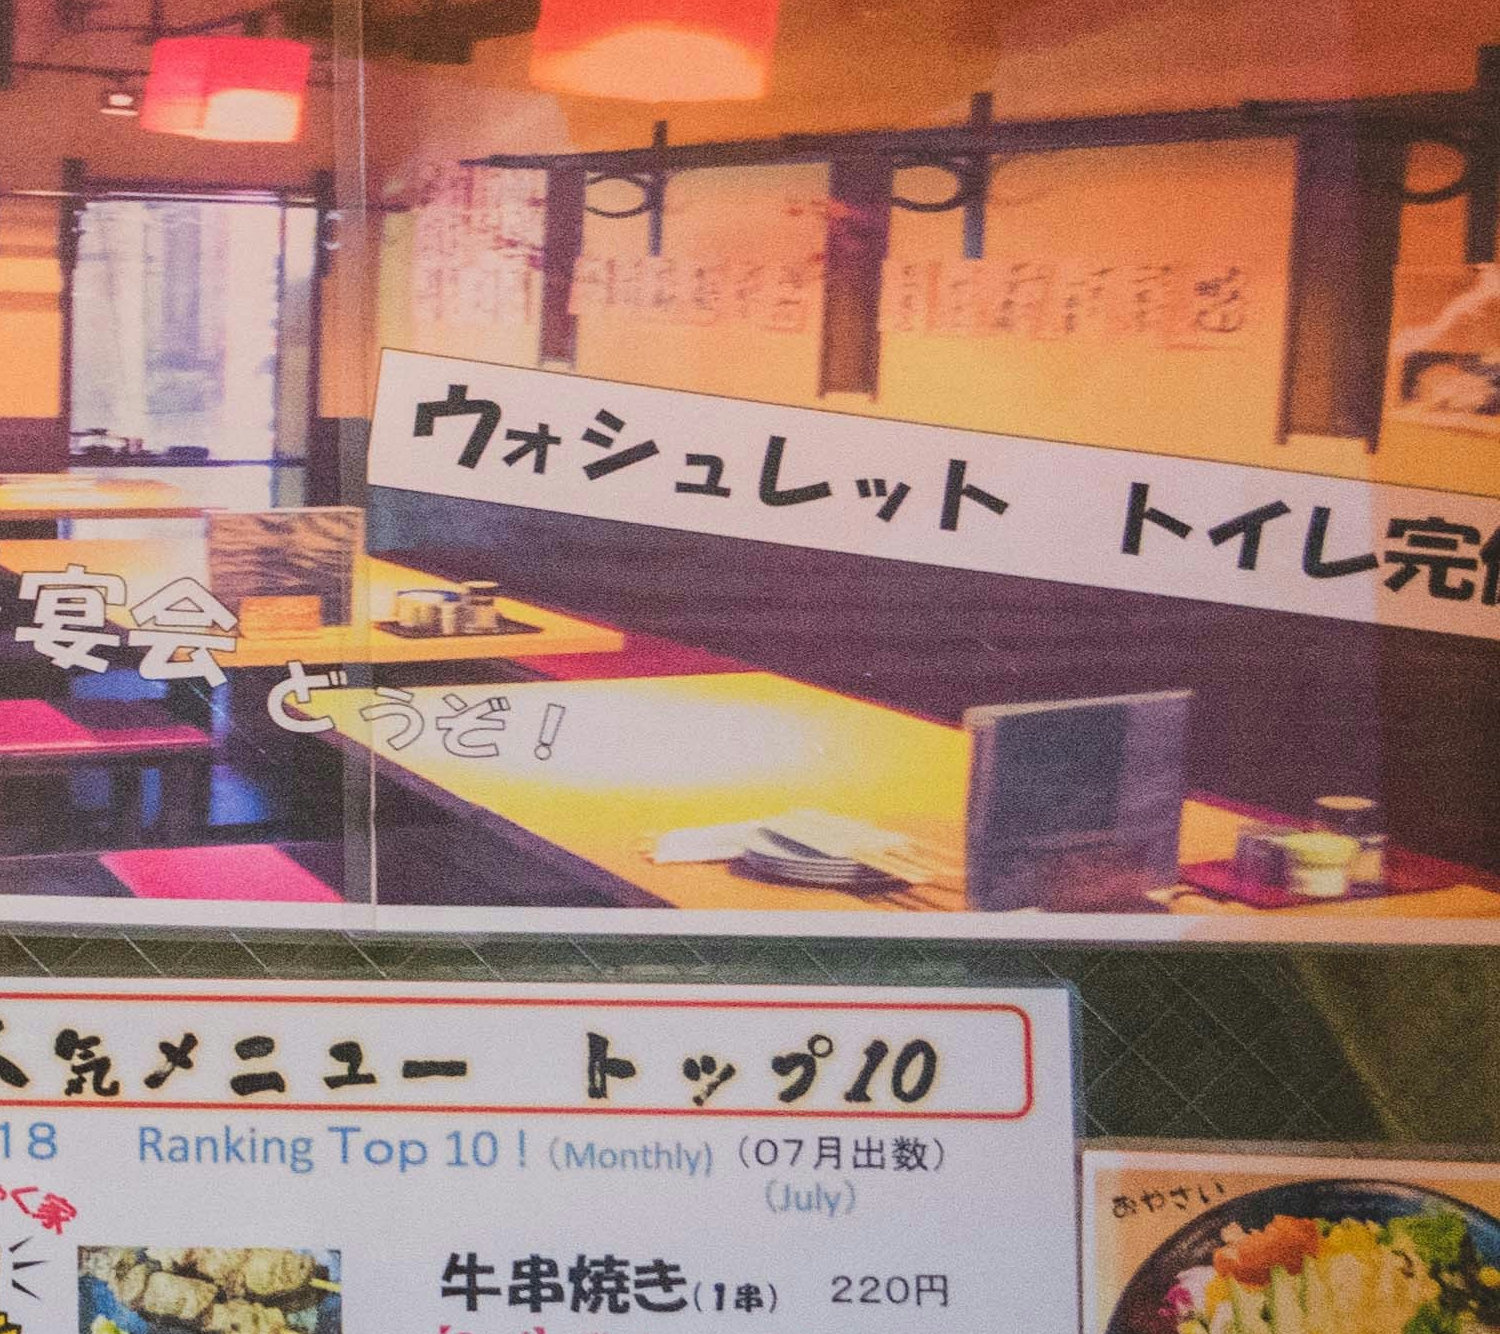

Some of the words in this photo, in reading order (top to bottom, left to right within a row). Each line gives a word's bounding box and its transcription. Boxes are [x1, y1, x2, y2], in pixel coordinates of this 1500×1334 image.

[411, 383, 1008, 532] ウォシュレット
[584, 1030, 939, 1106] トップ10
[138, 1125, 315, 1174] Ranking
[327, 1125, 428, 1172] Top
[830, 1274, 950, 1309] 220円
